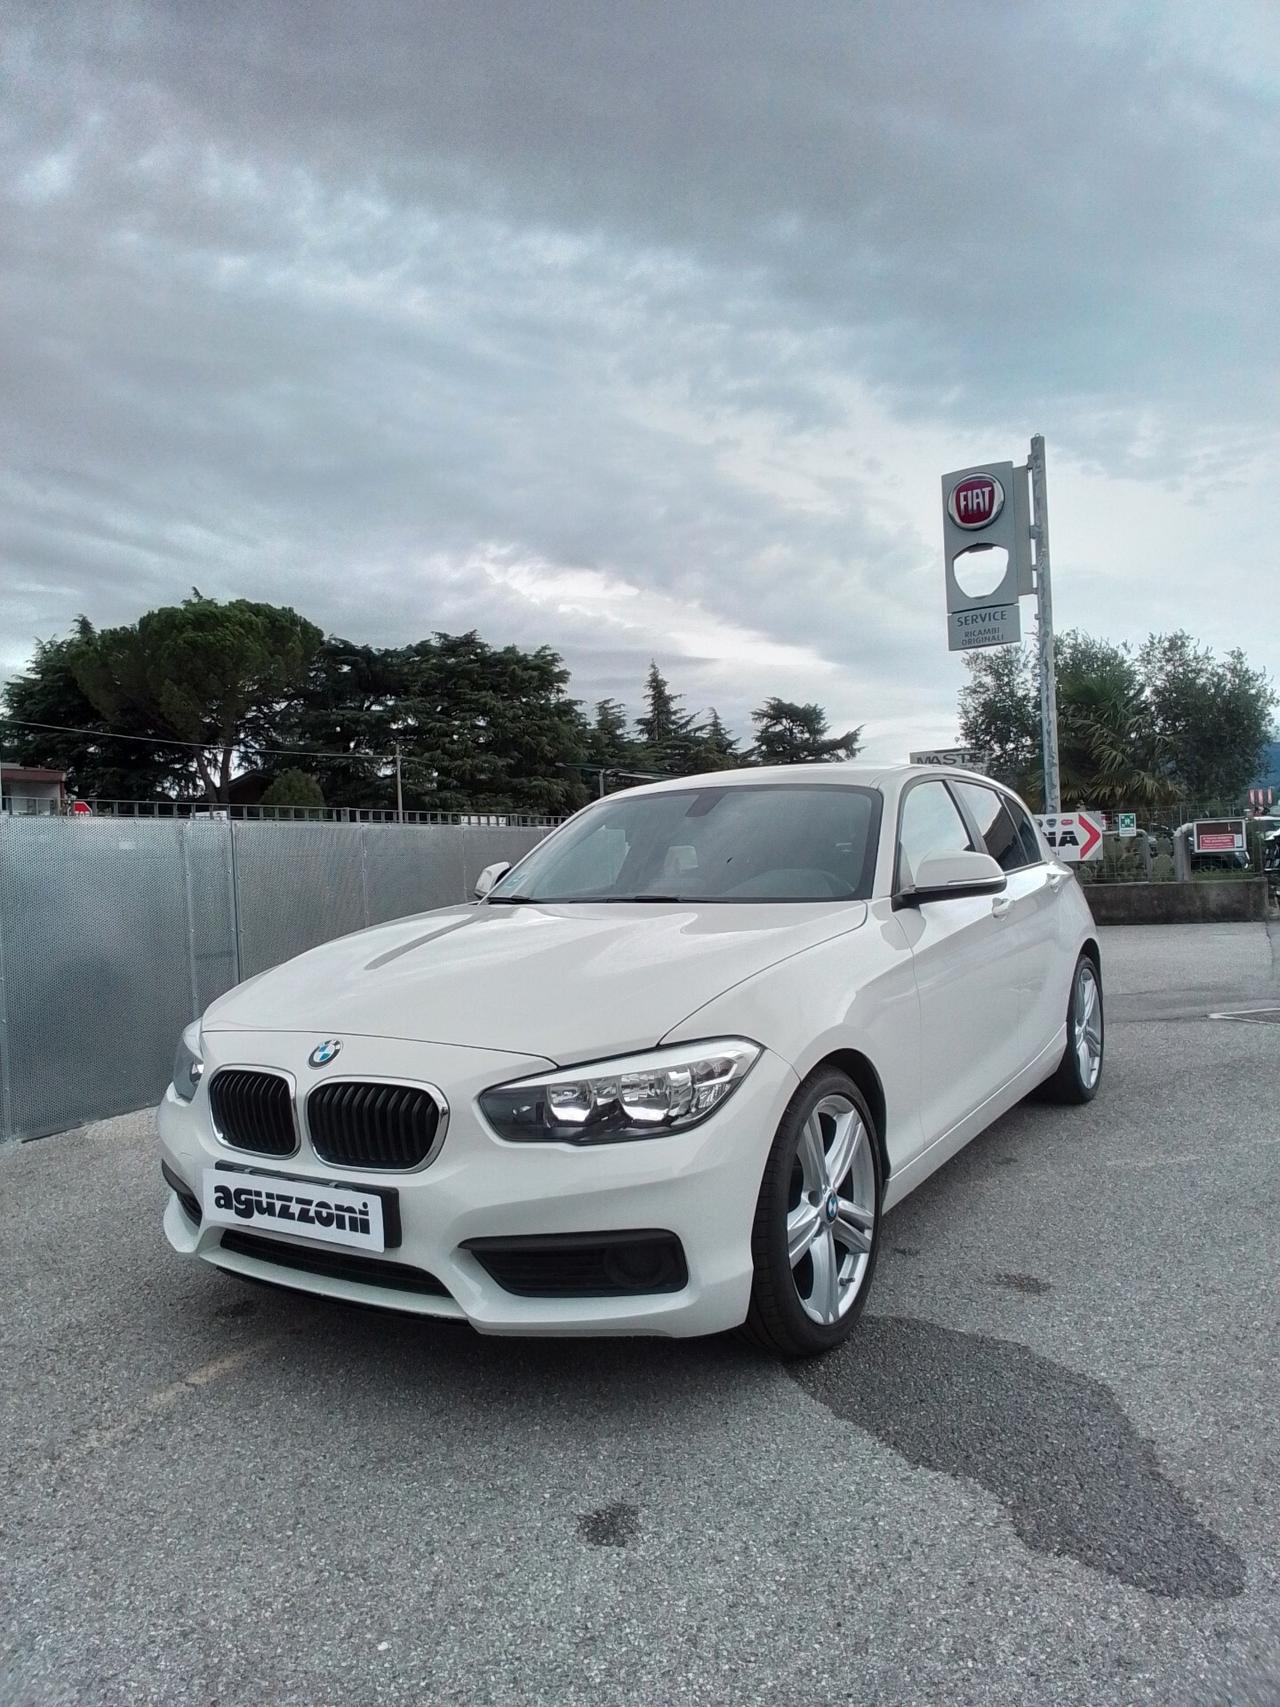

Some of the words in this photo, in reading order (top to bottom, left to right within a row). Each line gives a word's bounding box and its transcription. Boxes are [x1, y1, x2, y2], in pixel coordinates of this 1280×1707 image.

[959, 486, 992, 516] FIAT
[956, 610, 1008, 628] SERVICE
[961, 633, 1004, 646] ORIGINALI
[964, 627, 1000, 638] RICAMBI
[213, 1184, 371, 1235] aguzzoni
